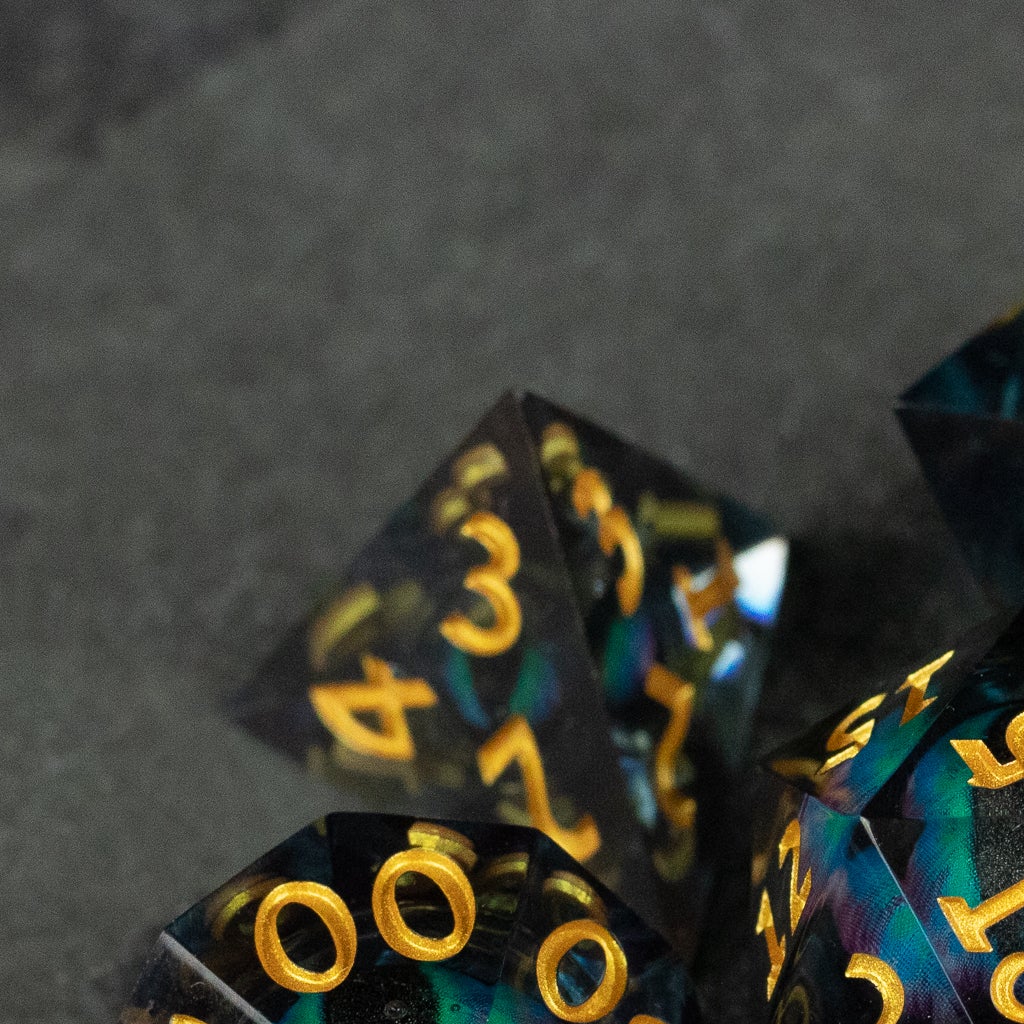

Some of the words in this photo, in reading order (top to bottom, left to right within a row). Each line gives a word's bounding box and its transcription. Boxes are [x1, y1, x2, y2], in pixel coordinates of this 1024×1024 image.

[438, 511, 522, 656] 3
[309, 654, 438, 764] 4
[252, 847, 477, 994] 00
